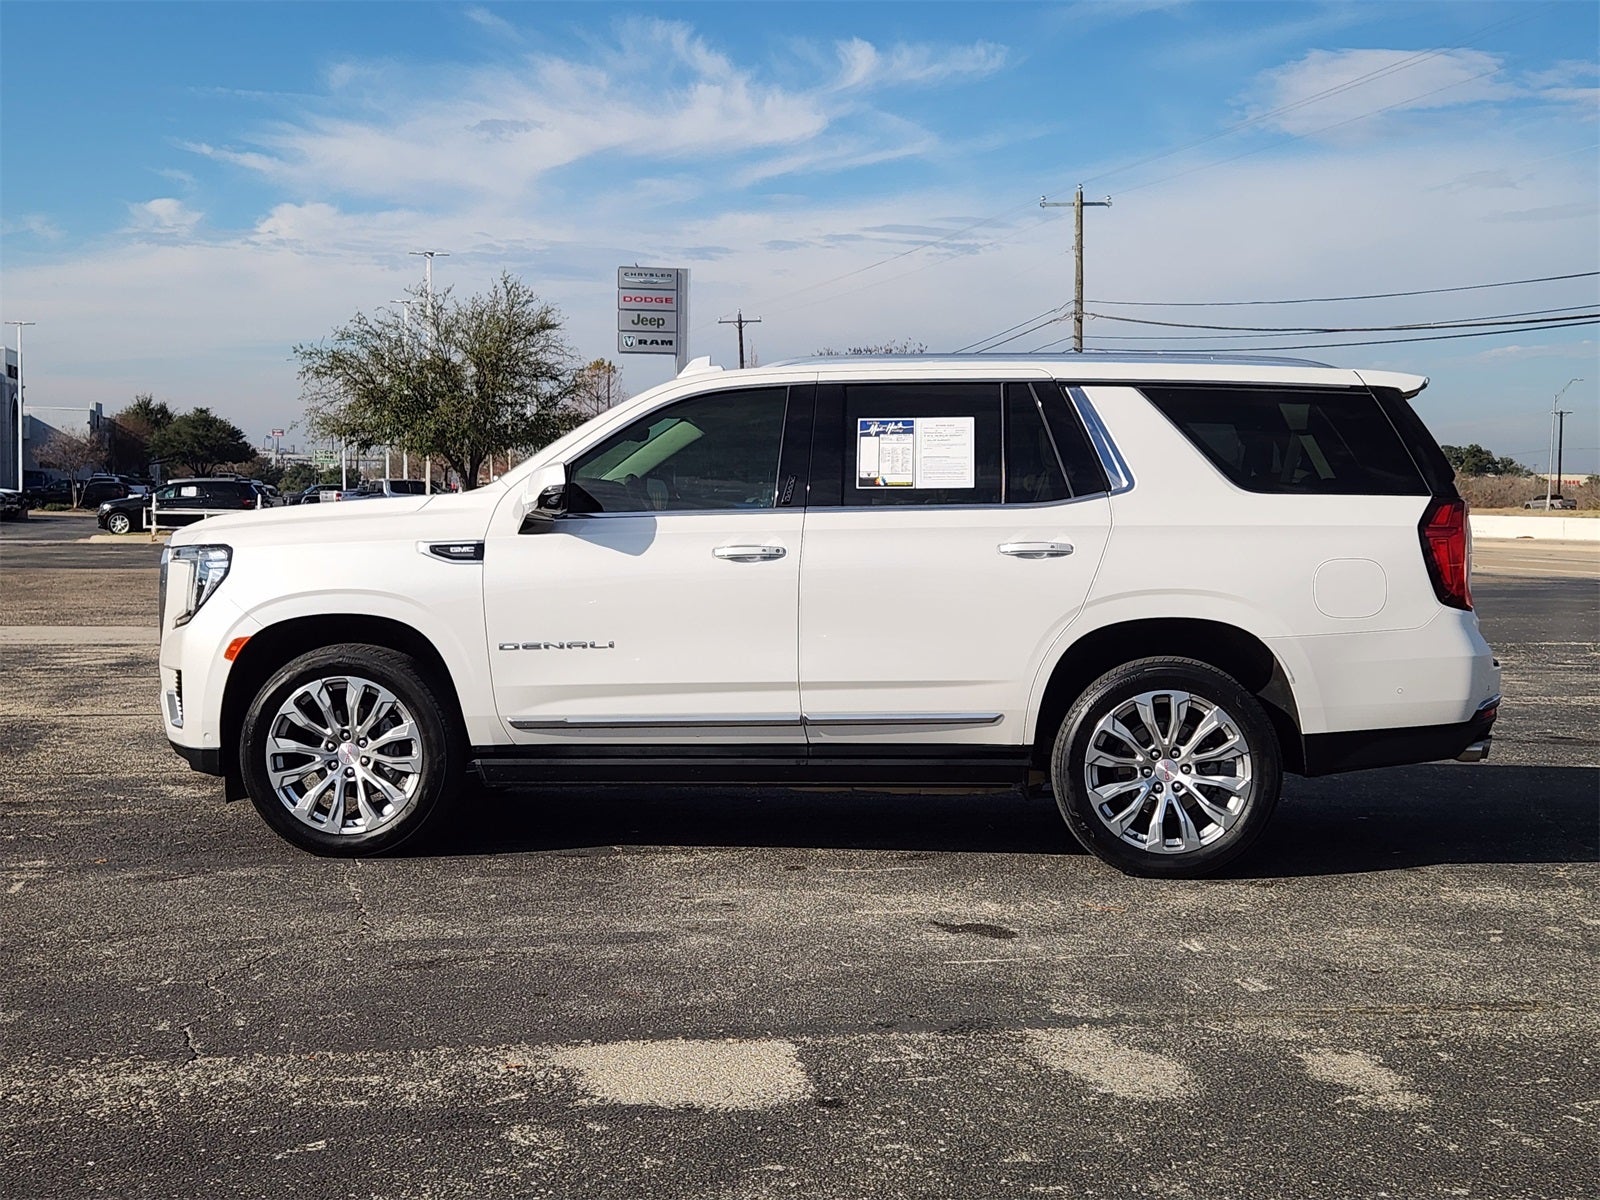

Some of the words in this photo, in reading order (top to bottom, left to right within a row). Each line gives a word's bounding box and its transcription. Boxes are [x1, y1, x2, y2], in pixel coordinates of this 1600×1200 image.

[622, 296, 674, 304] DODGE
[631, 313, 666, 329] Jeep
[637, 338, 674, 346] RAM
[499, 641, 615, 650] DENALI
